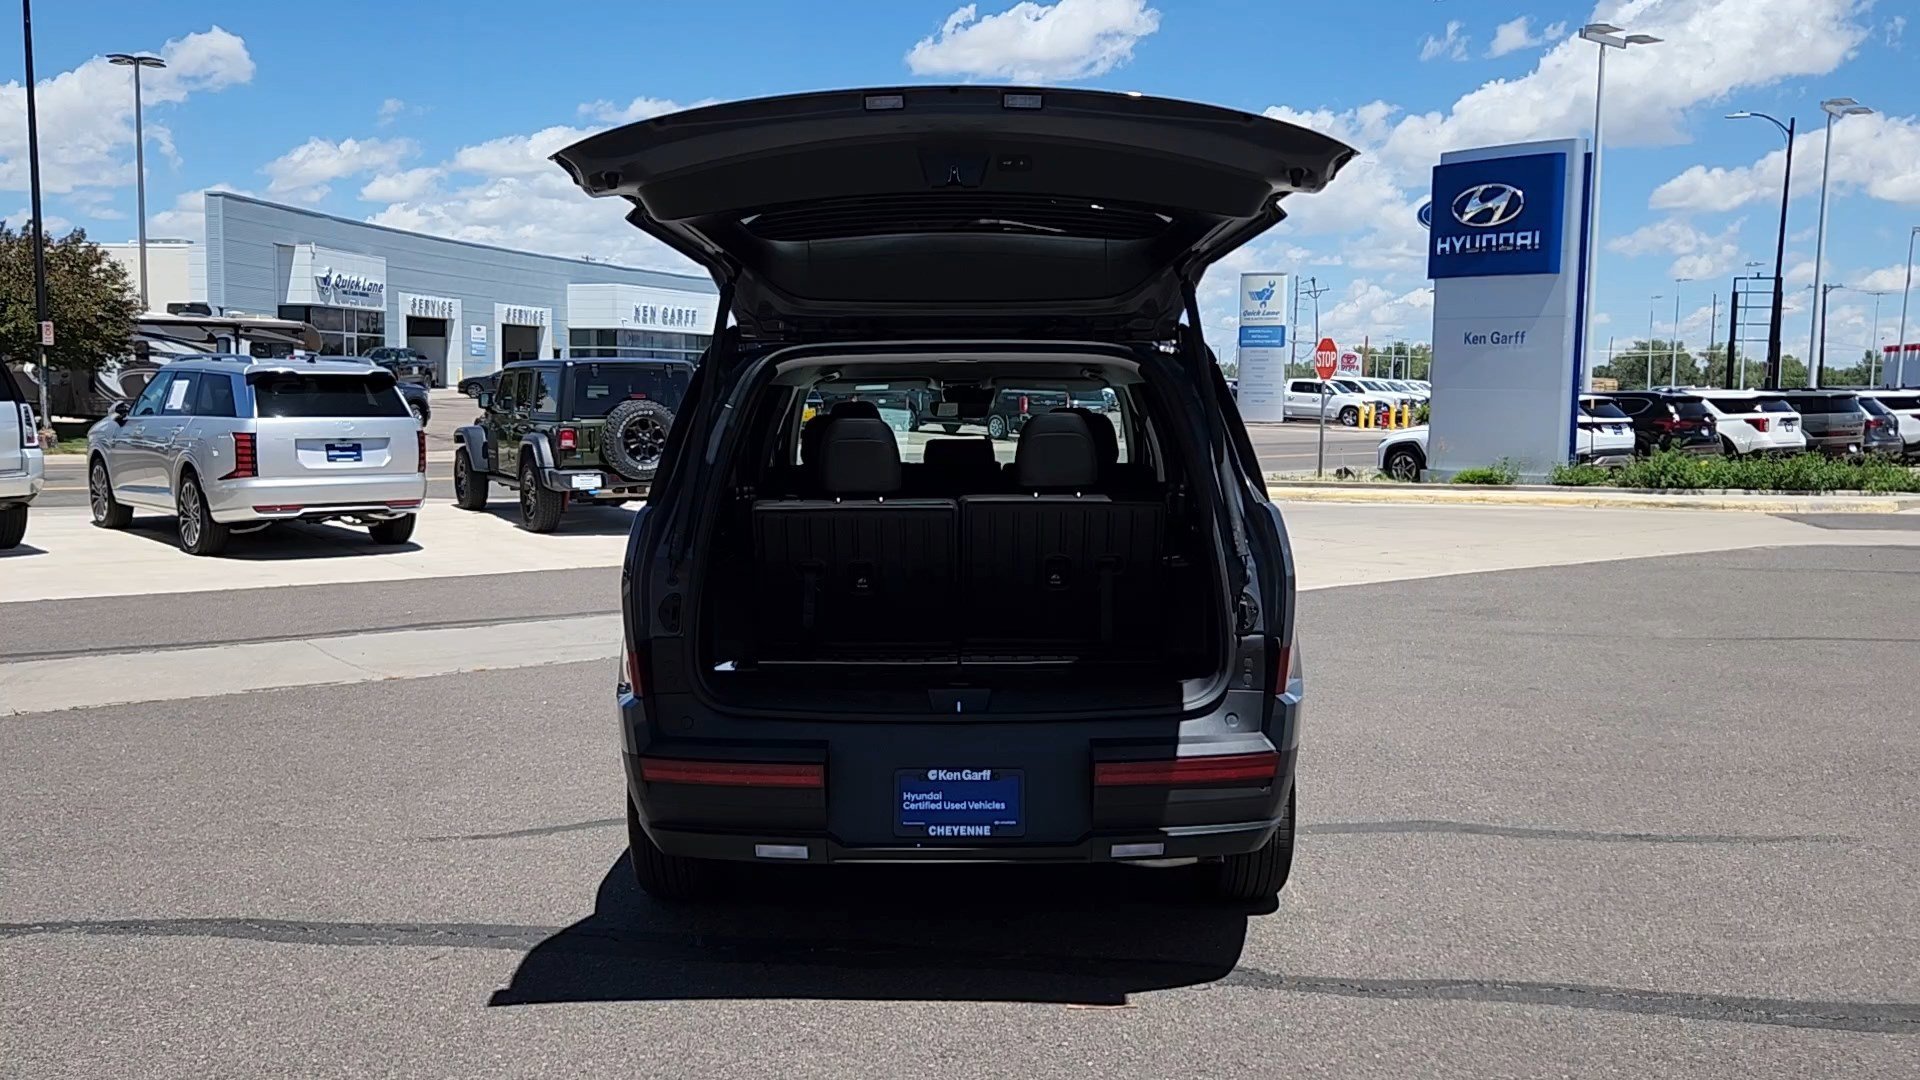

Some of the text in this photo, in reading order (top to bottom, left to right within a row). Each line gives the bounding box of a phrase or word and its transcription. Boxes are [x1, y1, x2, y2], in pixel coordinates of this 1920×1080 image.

[1436, 230, 1540, 255] HYUNDAI
[334, 273, 384, 293] Quick Lane
[411, 297, 453, 313] SERVICE
[506, 307, 545, 321] SERVICE
[634, 304, 698, 323] KEN GARFF
[1242, 308, 1260, 317] Quick
[1464, 330, 1526, 345] Ken Garff
[1316, 351, 1337, 368] STOP
[938, 769, 992, 780] Ken Garff
[903, 791, 943, 801] Hyundai
[903, 801, 1006, 810] Certified Used Vehicles
[928, 825, 991, 836] CHEYENNE
